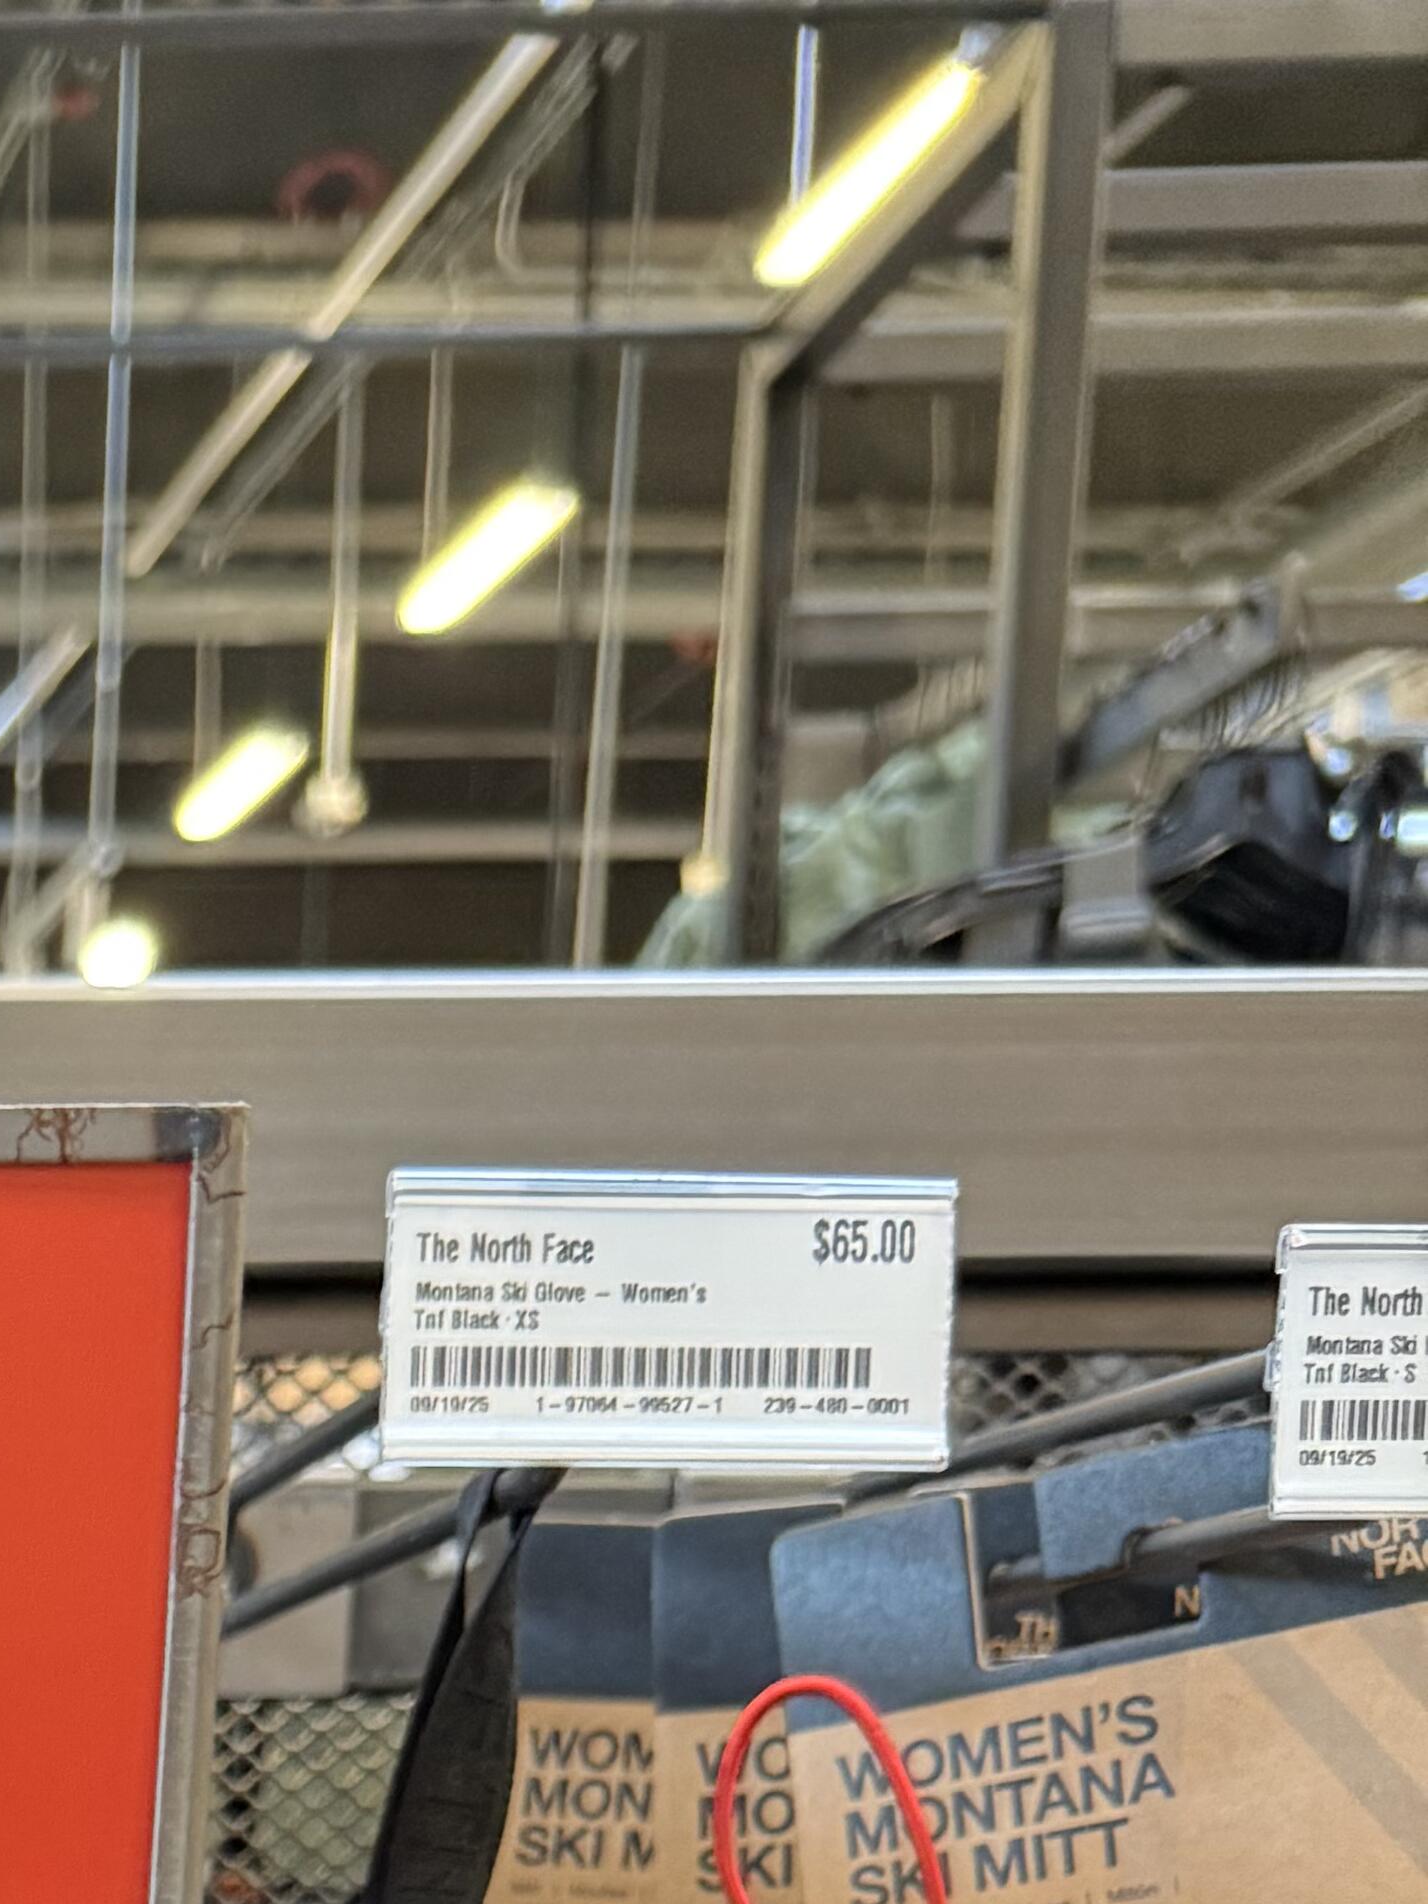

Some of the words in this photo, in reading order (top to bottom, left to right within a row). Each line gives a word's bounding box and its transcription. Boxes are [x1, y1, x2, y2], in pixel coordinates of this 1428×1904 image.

[417, 1231, 459, 1264] The
[470, 1232, 532, 1264] North
[543, 1233, 595, 1265] Face
[812, 1218, 916, 1267] $65.00
[416, 1281, 494, 1303] Montana
[535, 1281, 586, 1303] Glove
[621, 1282, 707, 1304] Women's
[1308, 1285, 1351, 1317] The
[1360, 1286, 1423, 1317] North
[451, 1309, 499, 1330] Black
[515, 1310, 540, 1331] XS
[1306, 1334, 1383, 1356] Montana
[1340, 1362, 1389, 1385] Black
[835, 1694, 1159, 1801] WOMEN'S
[844, 1752, 1176, 1860] MONTANA
[514, 1825, 605, 1869] SKI
[971, 1817, 1130, 1892] MITT
